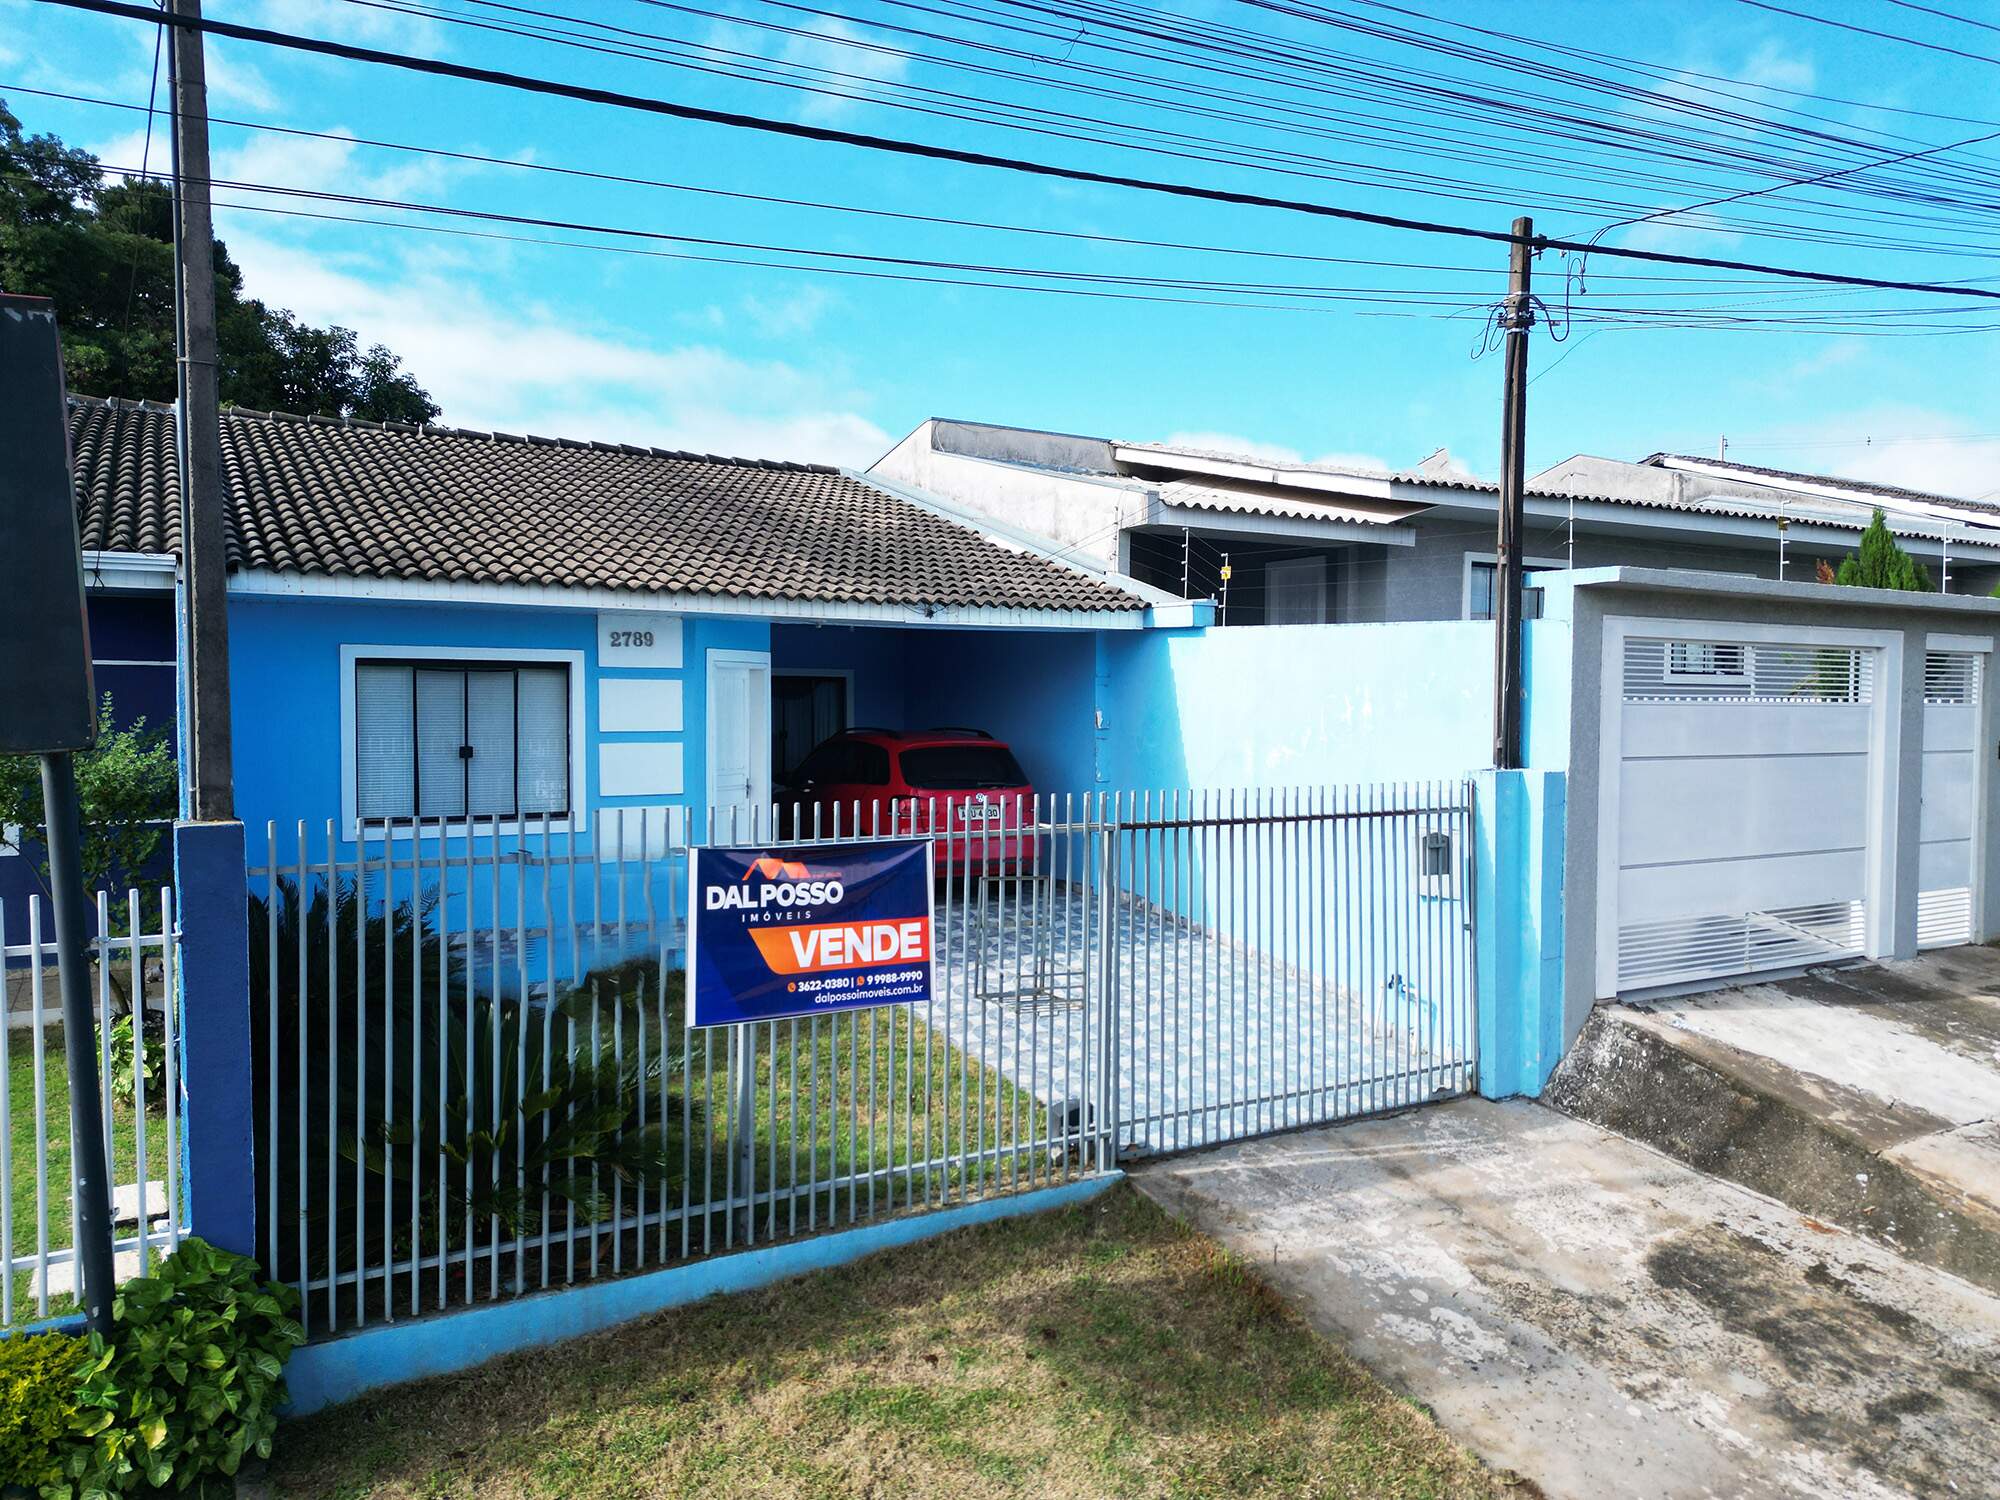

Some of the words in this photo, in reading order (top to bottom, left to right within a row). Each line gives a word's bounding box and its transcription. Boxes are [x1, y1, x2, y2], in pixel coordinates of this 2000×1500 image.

[610, 631, 654, 648] 2789
[742, 910, 812, 923] IMÓVEIS
[789, 922, 922, 968] VENDE
[798, 978, 849, 992] 3622-0380
[815, 984, 924, 1004] dalpossoimoveis.com.br
